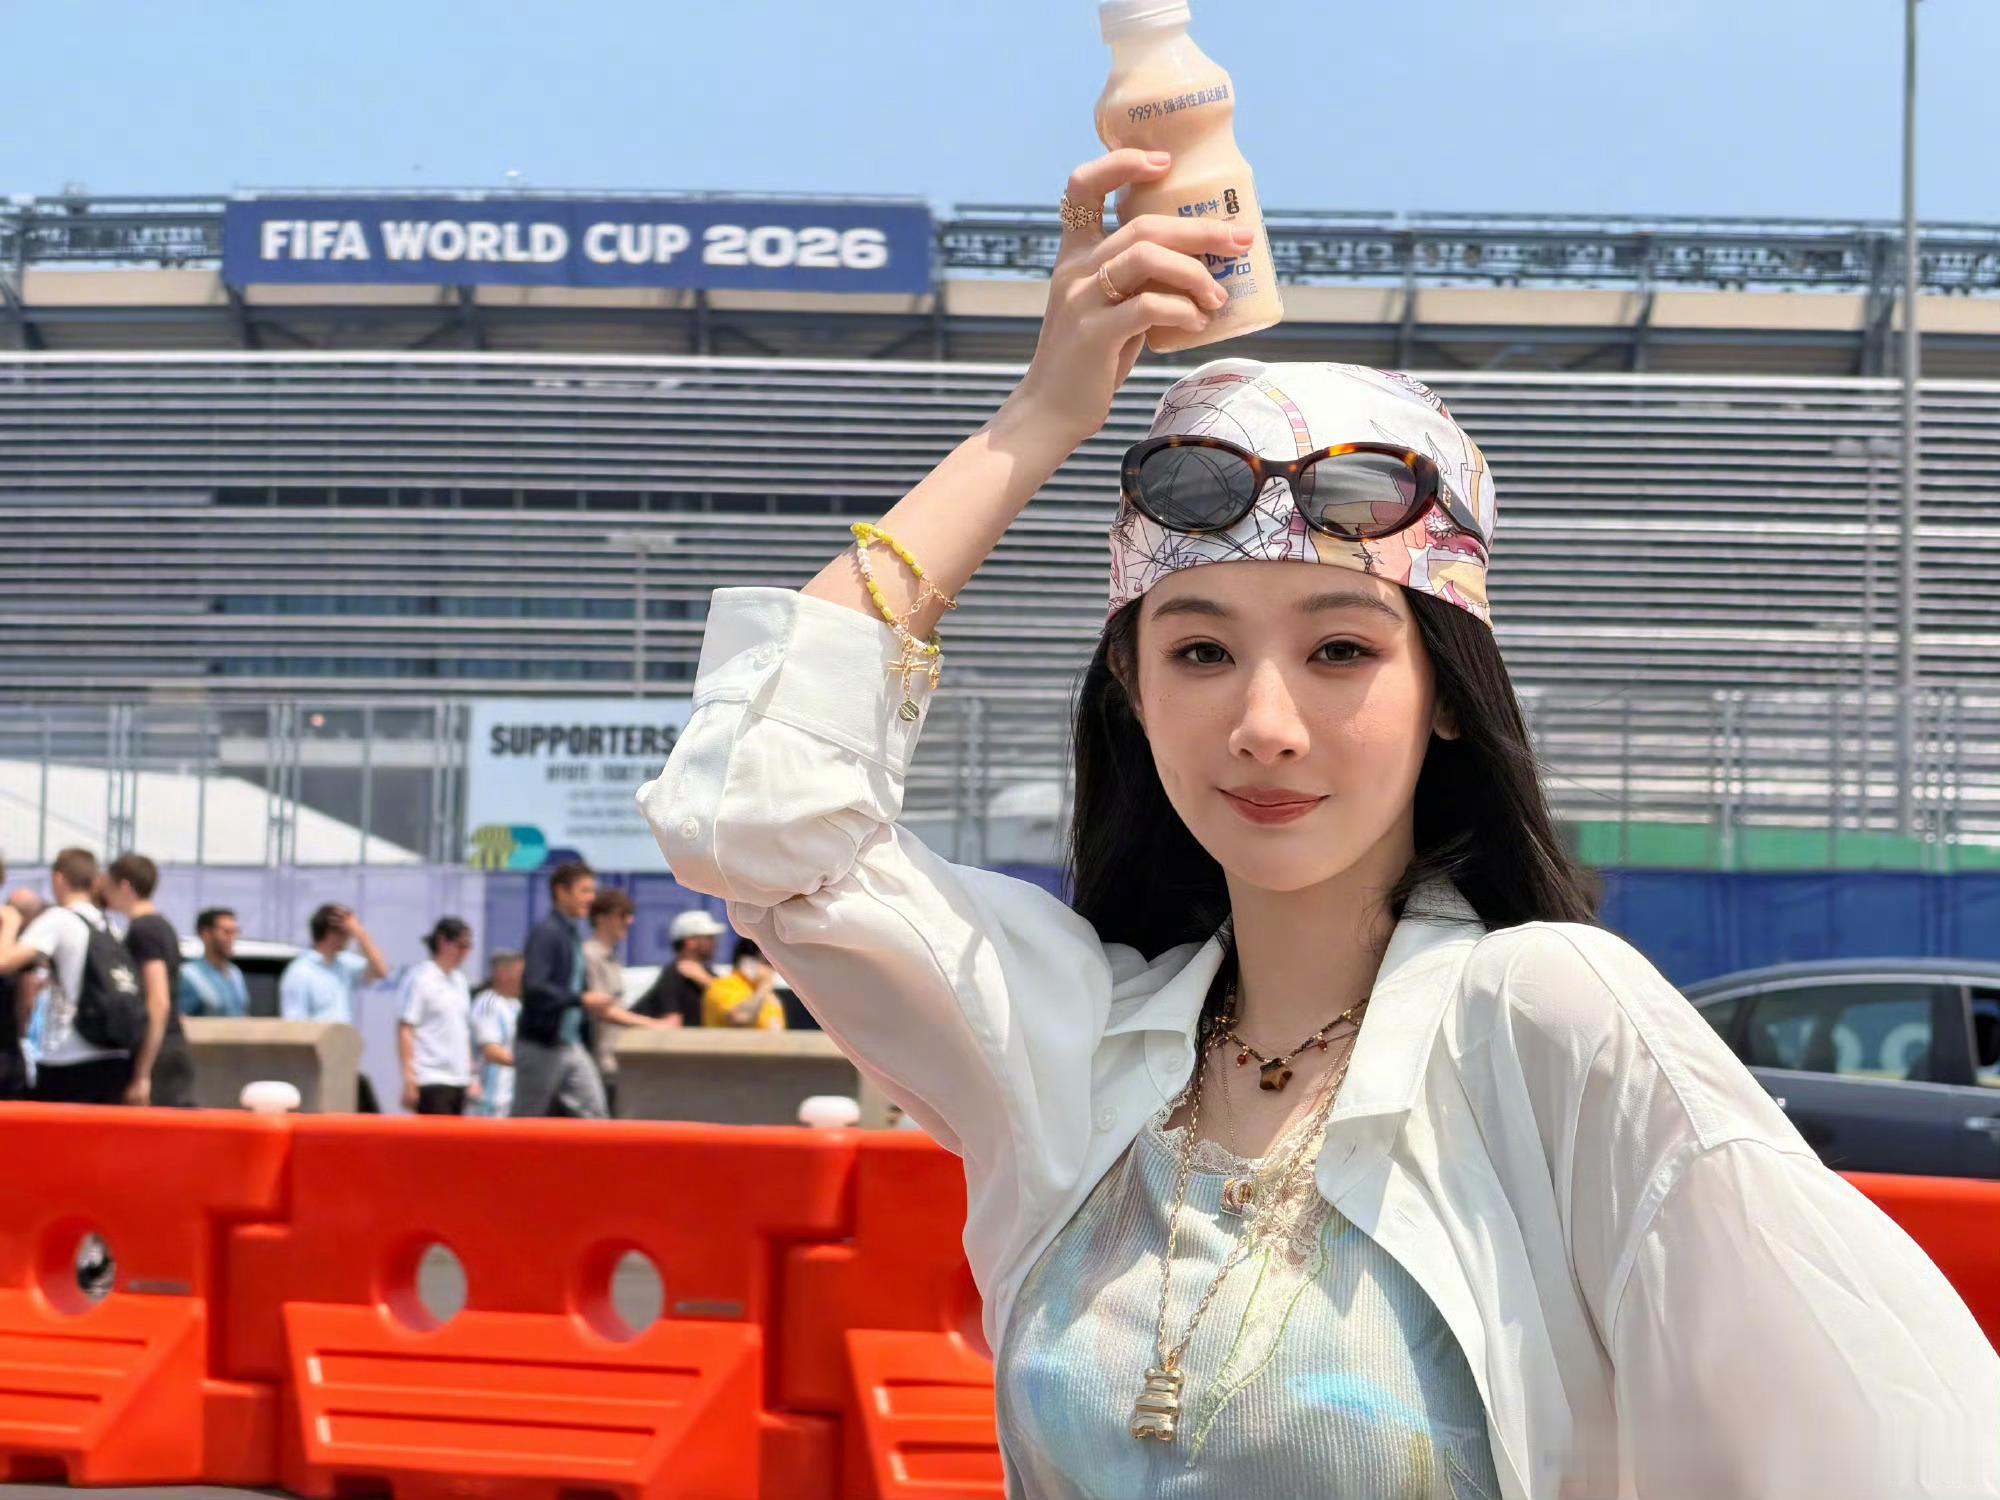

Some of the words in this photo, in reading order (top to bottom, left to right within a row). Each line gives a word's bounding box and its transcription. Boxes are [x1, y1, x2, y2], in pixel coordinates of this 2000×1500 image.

[260, 220, 370, 261] FIFA
[380, 219, 569, 263] WORLD
[584, 222, 690, 264] CUP
[702, 224, 889, 269] 2026
[490, 725, 678, 756] SUPPORTERS
